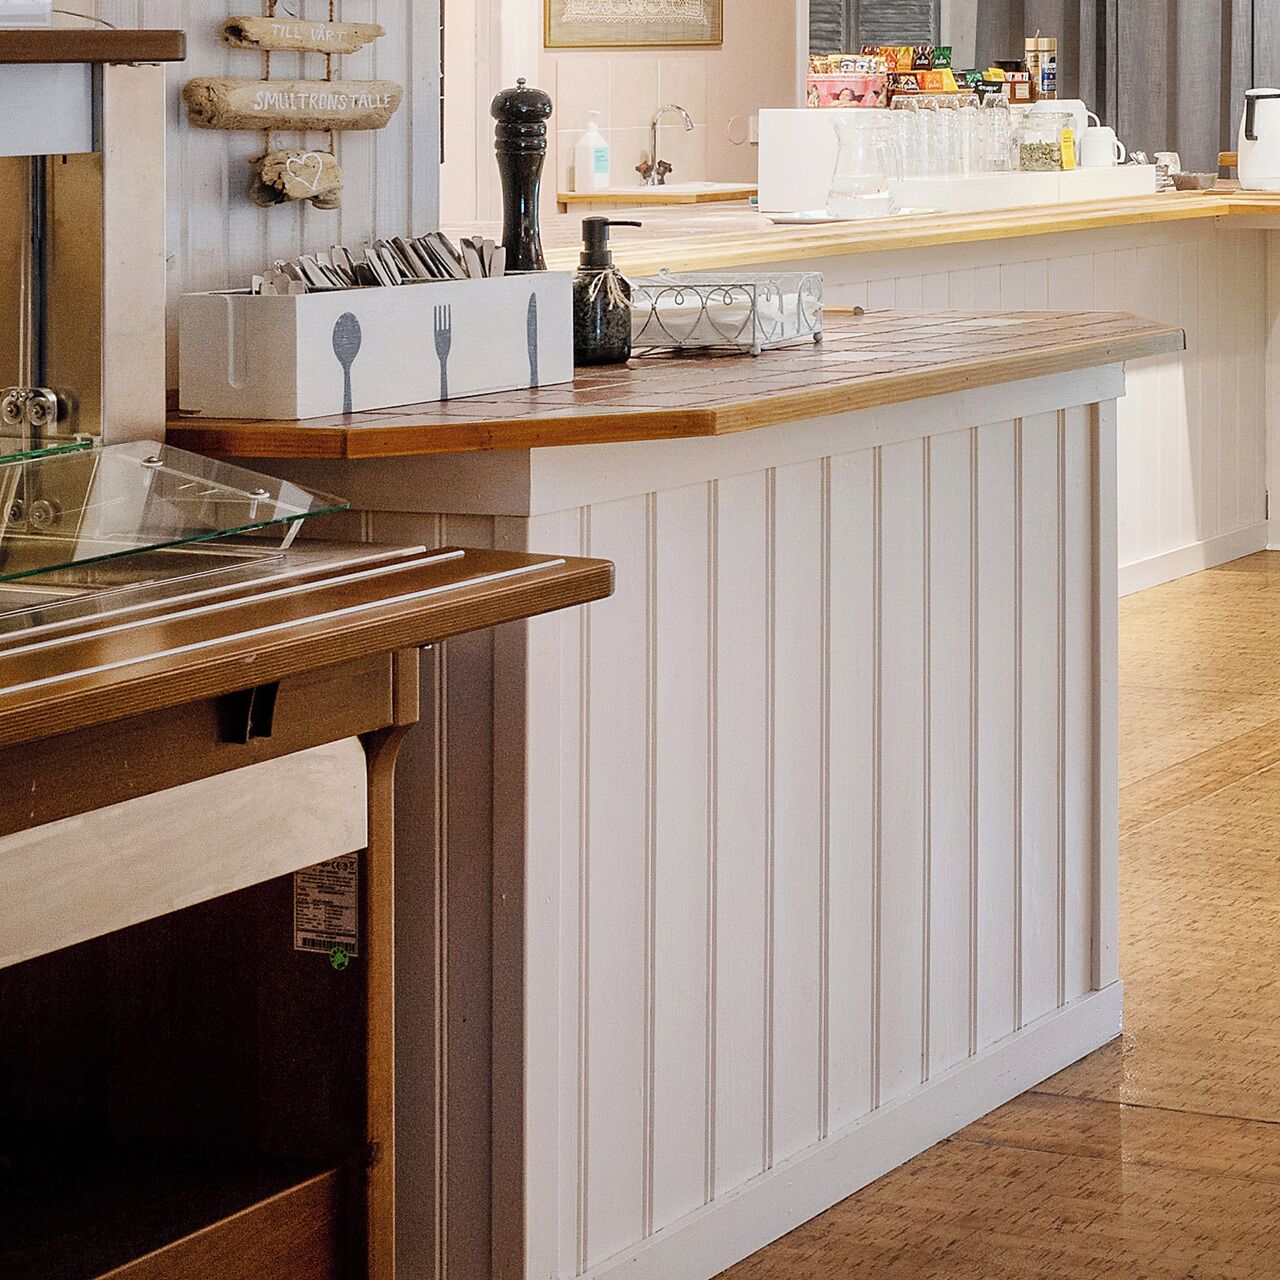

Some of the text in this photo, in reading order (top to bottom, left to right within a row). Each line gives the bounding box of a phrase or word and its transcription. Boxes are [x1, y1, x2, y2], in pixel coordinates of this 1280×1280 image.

[271, 23, 348, 42] TILL VÅRT
[254, 91, 391, 111] SMULTRONSTÄLLE
